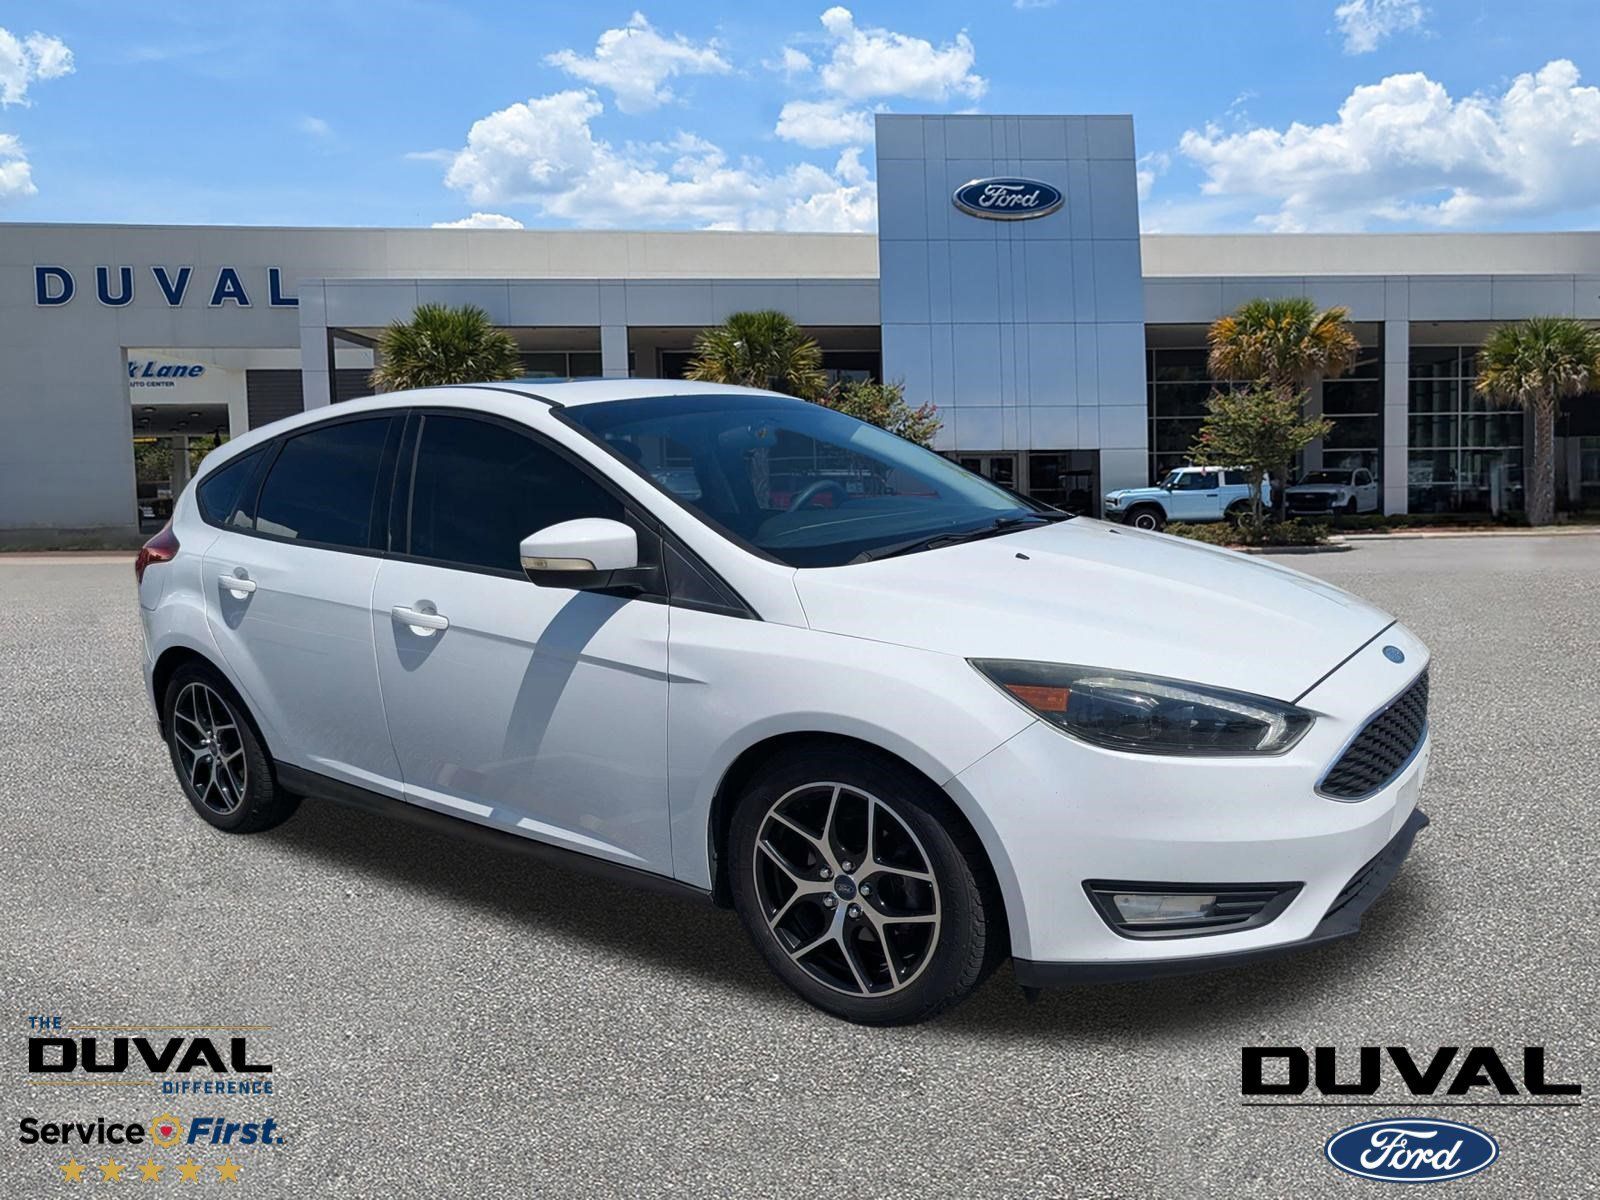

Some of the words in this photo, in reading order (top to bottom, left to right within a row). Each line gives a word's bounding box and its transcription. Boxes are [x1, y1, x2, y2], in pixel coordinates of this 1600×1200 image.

[978, 184, 1041, 207] Ford
[33, 265, 299, 308] DUVAL
[141, 361, 204, 378] Lane
